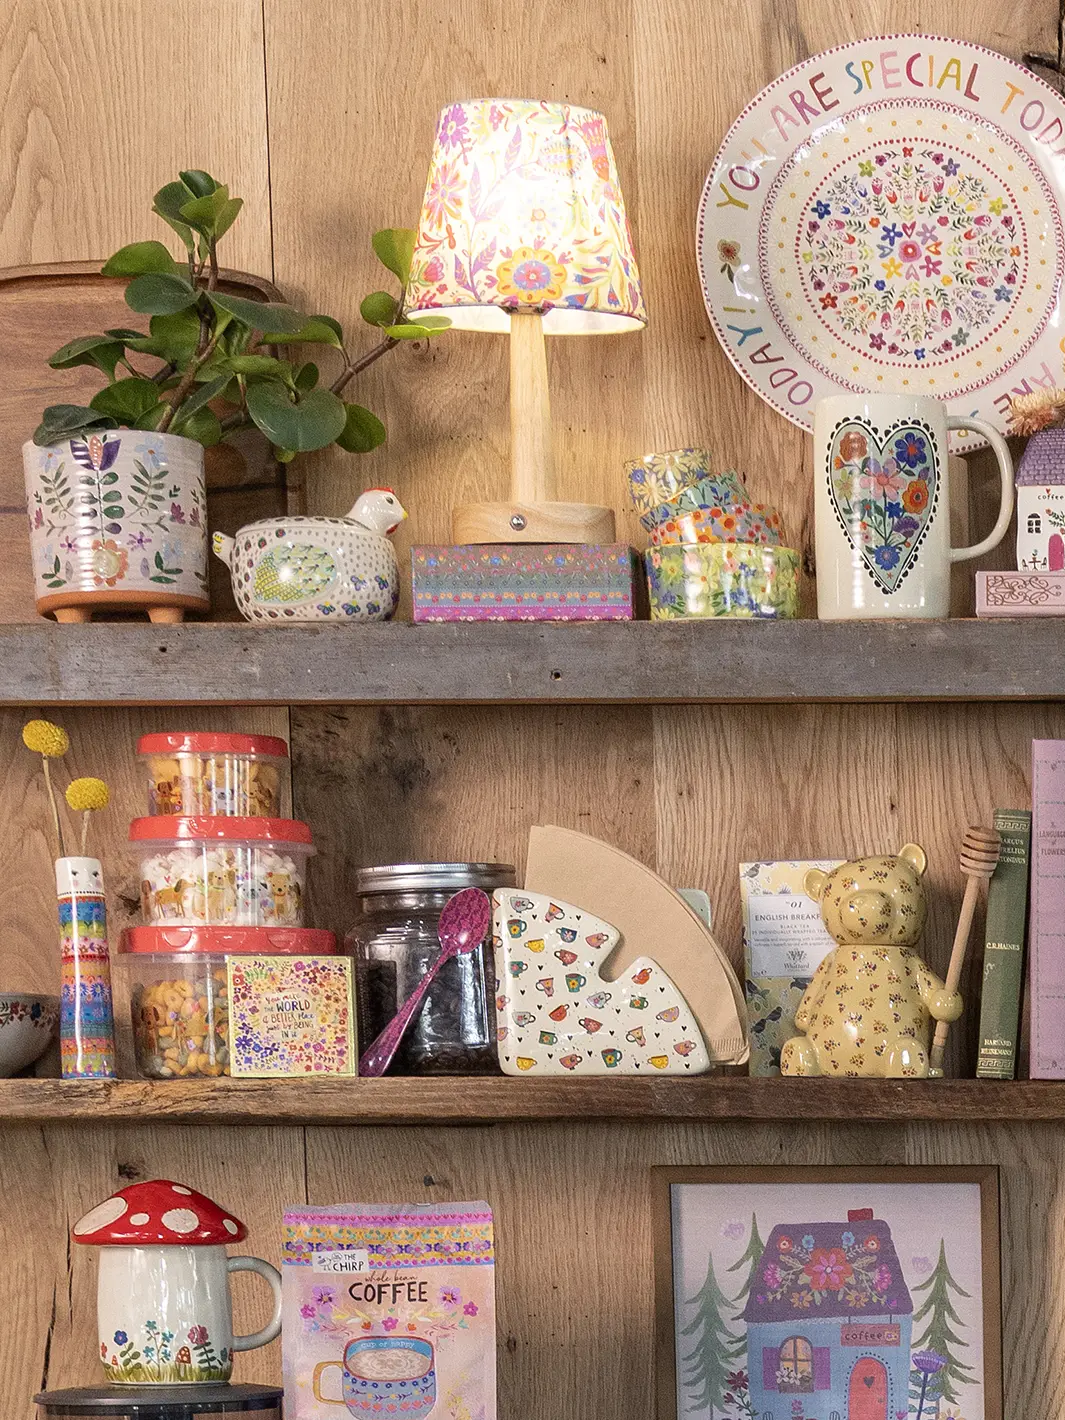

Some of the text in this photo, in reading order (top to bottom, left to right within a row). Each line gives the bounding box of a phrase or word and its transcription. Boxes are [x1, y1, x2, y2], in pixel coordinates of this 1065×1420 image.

[716, 137, 769, 211] YOU
[770, 72, 841, 142] ARE
[844, 51, 980, 102] SPECIAL
[722, 305, 816, 417] ODAY!
[1000, 838, 1025, 847] ARCUS
[754, 913, 822, 922] ENGLISH BREAKF
[276, 1000, 311, 1012] WORLD
[344, 1253, 357, 1261] THE
[332, 1261, 365, 1272] CHIRP
[364, 1269, 419, 1282] whole bean
[348, 1281, 429, 1305] COFFEE
[844, 1331, 883, 1341] coffee
